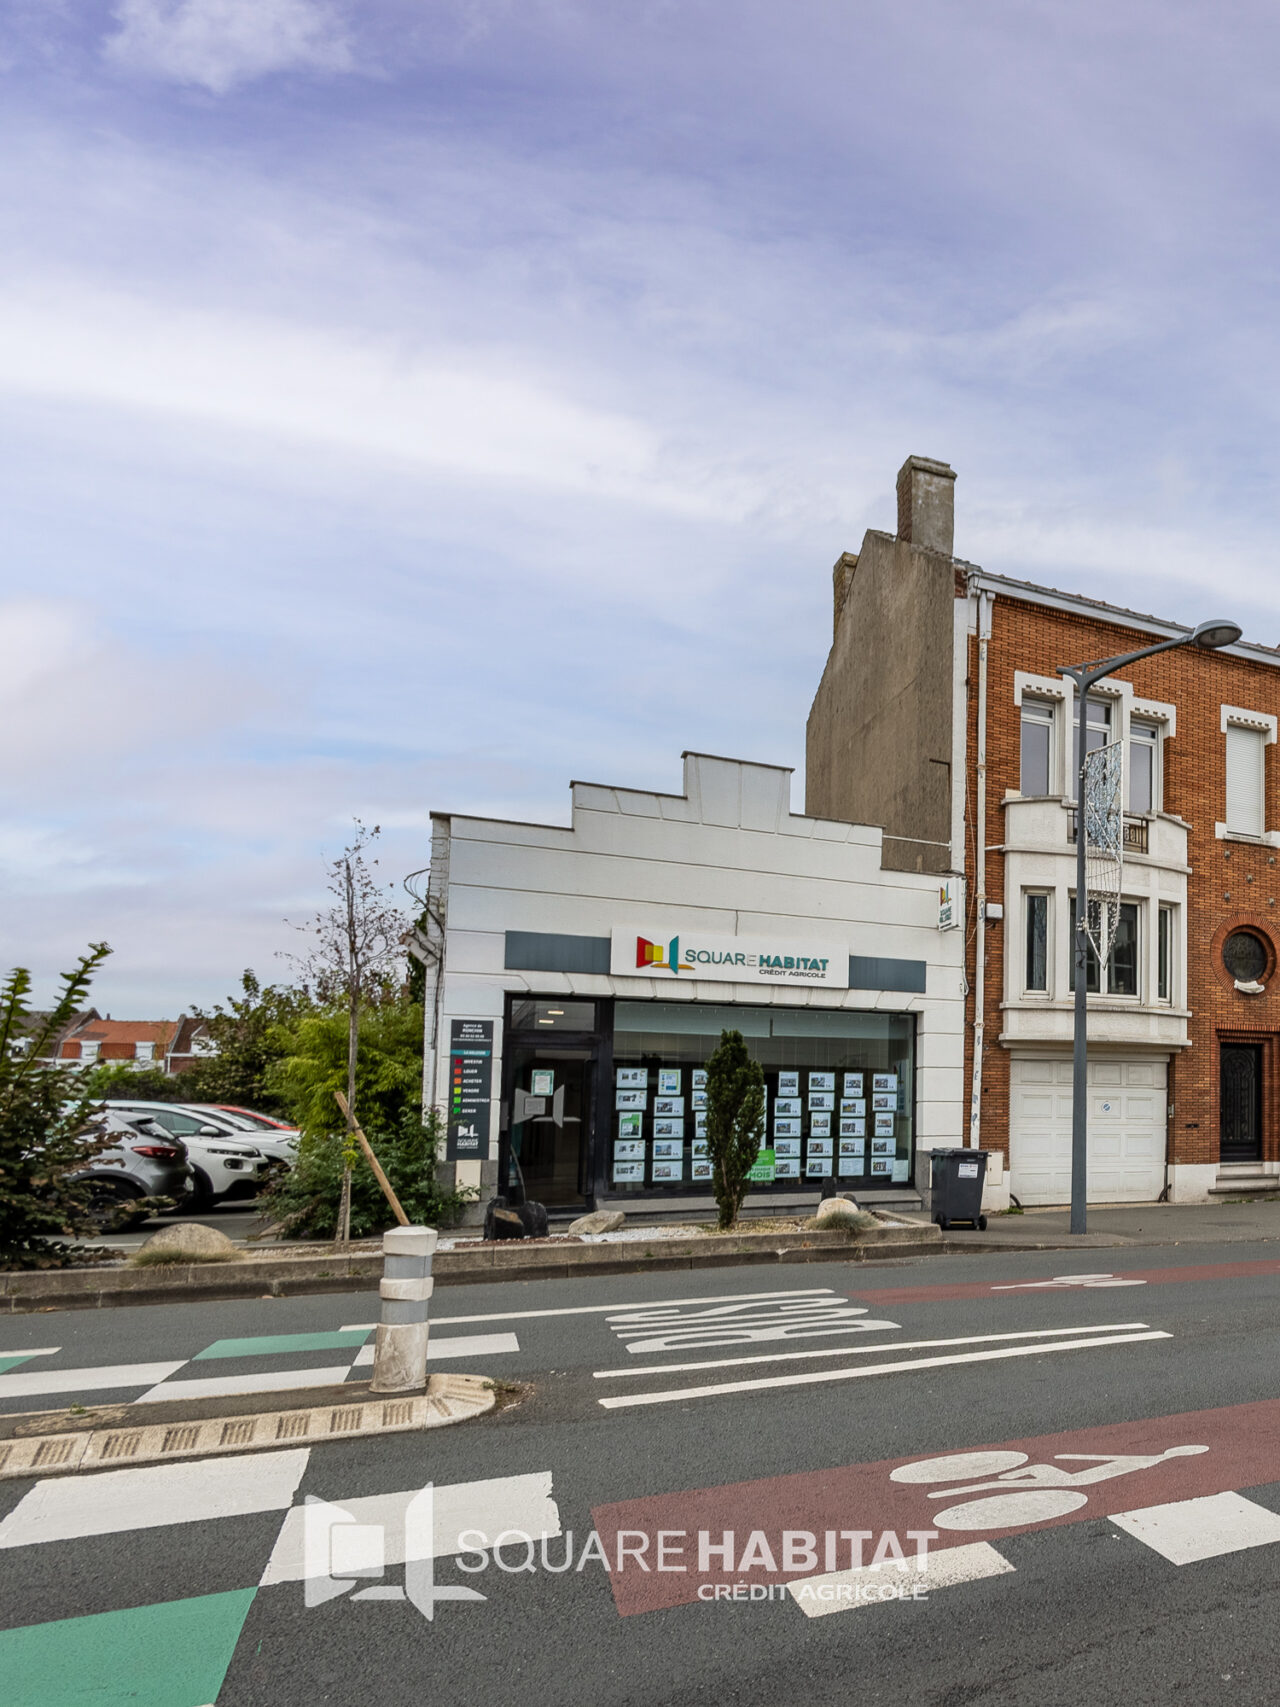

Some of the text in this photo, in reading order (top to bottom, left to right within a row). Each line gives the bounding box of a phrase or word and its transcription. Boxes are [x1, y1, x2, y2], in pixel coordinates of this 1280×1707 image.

[684, 949, 830, 972] SQUARE HABITAT
[788, 971, 827, 979] AGRICOLE
[605, 1297, 903, 1354] BUS
